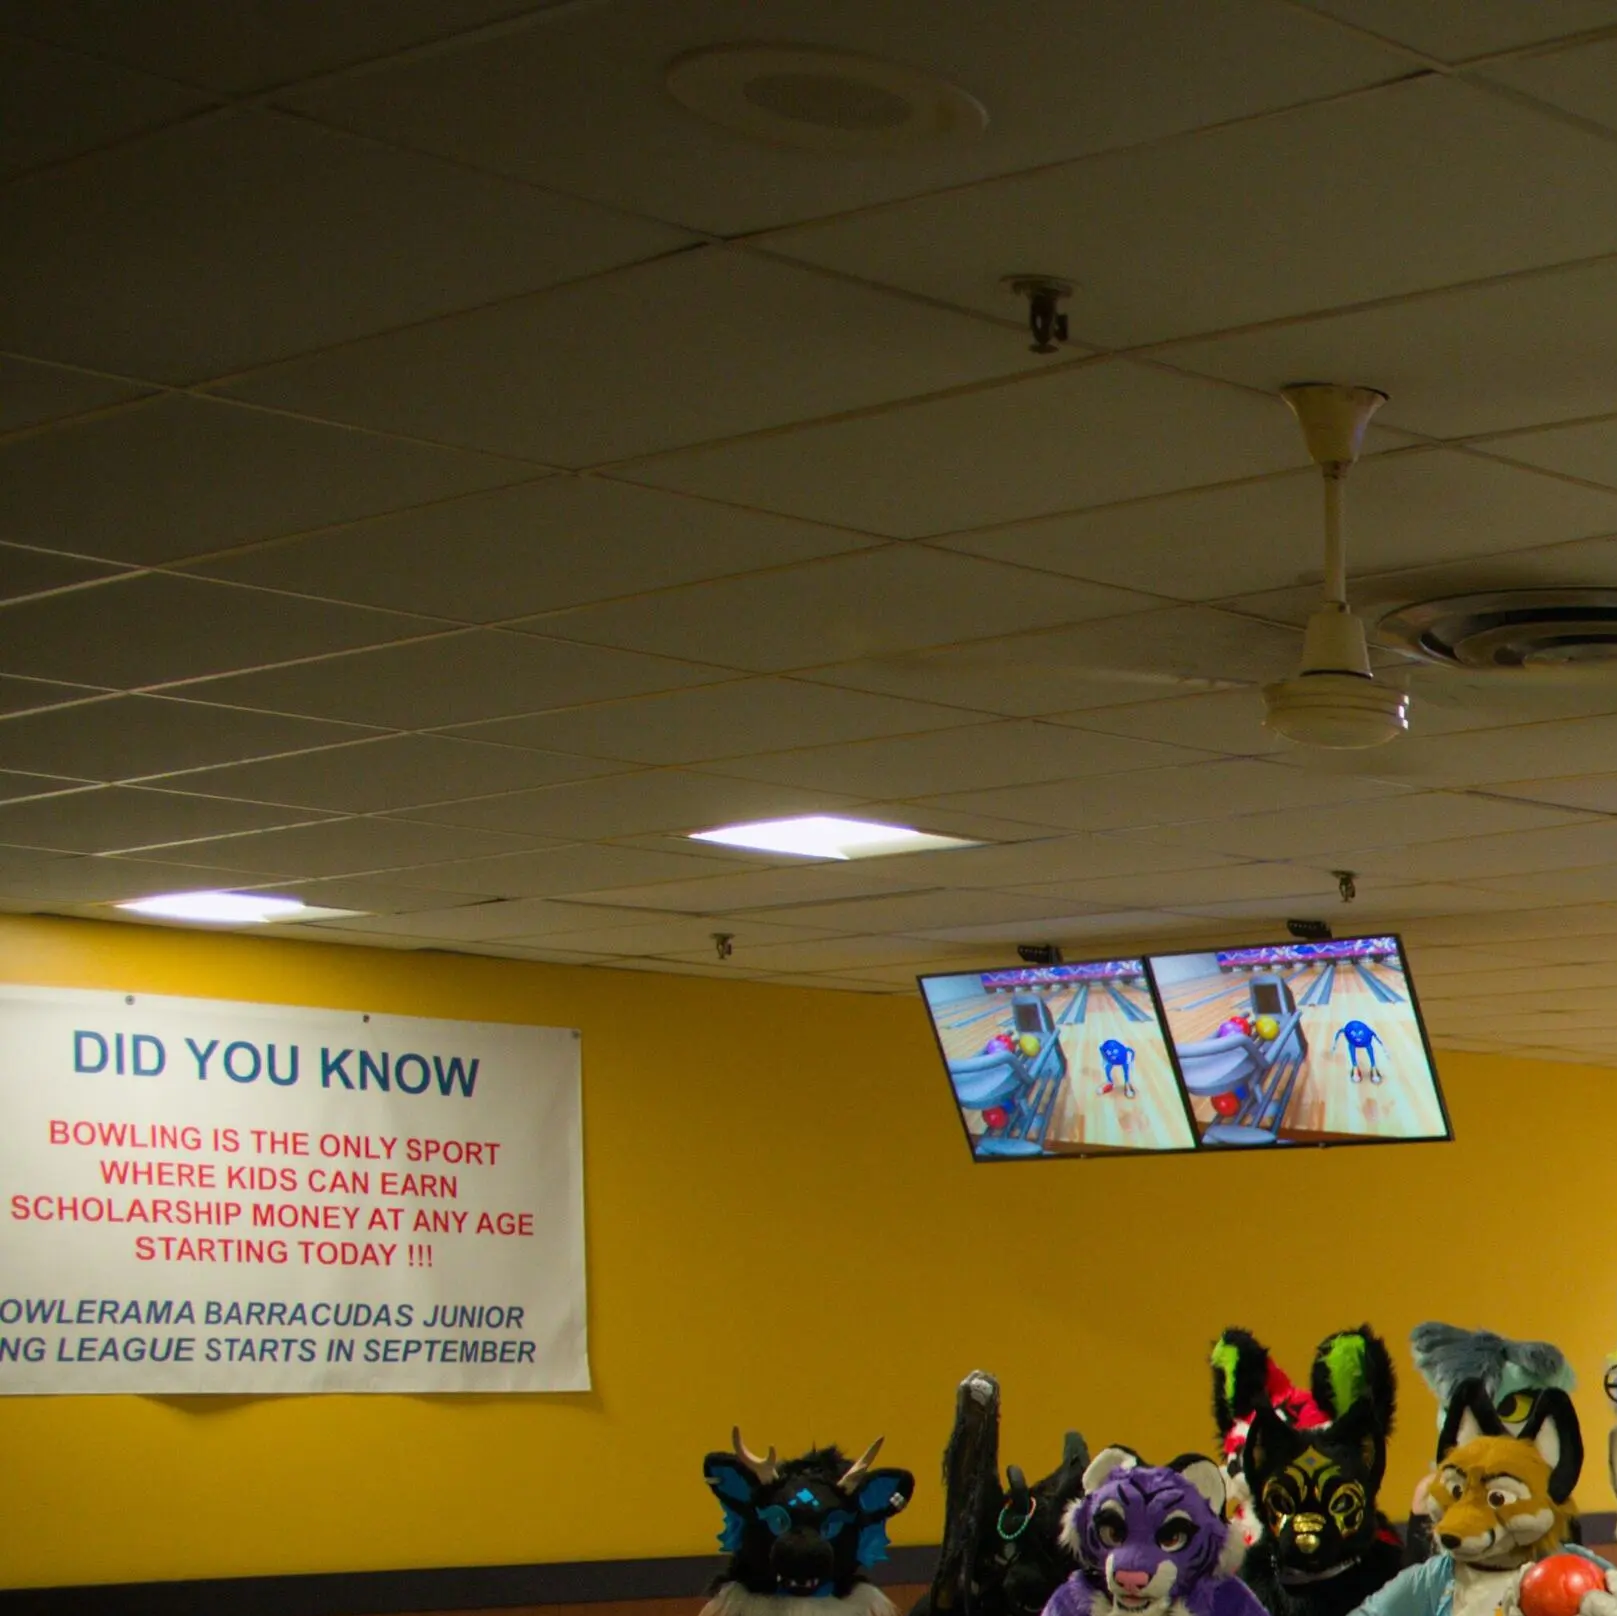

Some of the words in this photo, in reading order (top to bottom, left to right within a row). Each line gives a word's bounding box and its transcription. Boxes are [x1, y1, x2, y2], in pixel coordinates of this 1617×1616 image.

[73, 1030, 166, 1077] DID
[185, 1037, 299, 1086] YOU
[321, 1047, 479, 1098] KNOW
[49, 1119, 200, 1150] BOWLING
[213, 1129, 239, 1152] IS
[251, 1130, 308, 1156] THE
[320, 1133, 397, 1160] ONLY
[406, 1138, 500, 1165] SPORT
[100, 1161, 215, 1188] WHERE
[228, 1166, 297, 1192] KIDS
[308, 1170, 369, 1196] CAN
[381, 1173, 458, 1198] EARN
[11, 1195, 241, 1225] SCHOLARSHIP
[252, 1205, 360, 1230] MONEY
[367, 1208, 403, 1231] AT
[413, 1211, 470, 1233] ANY
[476, 1212, 534, 1236] AGE
[135, 1236, 287, 1264] STARTING
[297, 1242, 397, 1266] TODAY
[408, 1244, 432, 1268] !!!
[204, 1301, 413, 1329] BARRACUDAS
[423, 1305, 524, 1329] JUNIOR
[56, 1337, 195, 1363] LEAGUE
[204, 1339, 316, 1363] STARTS
[327, 1339, 354, 1363] IN
[363, 1339, 536, 1364] SEPTEMBER
